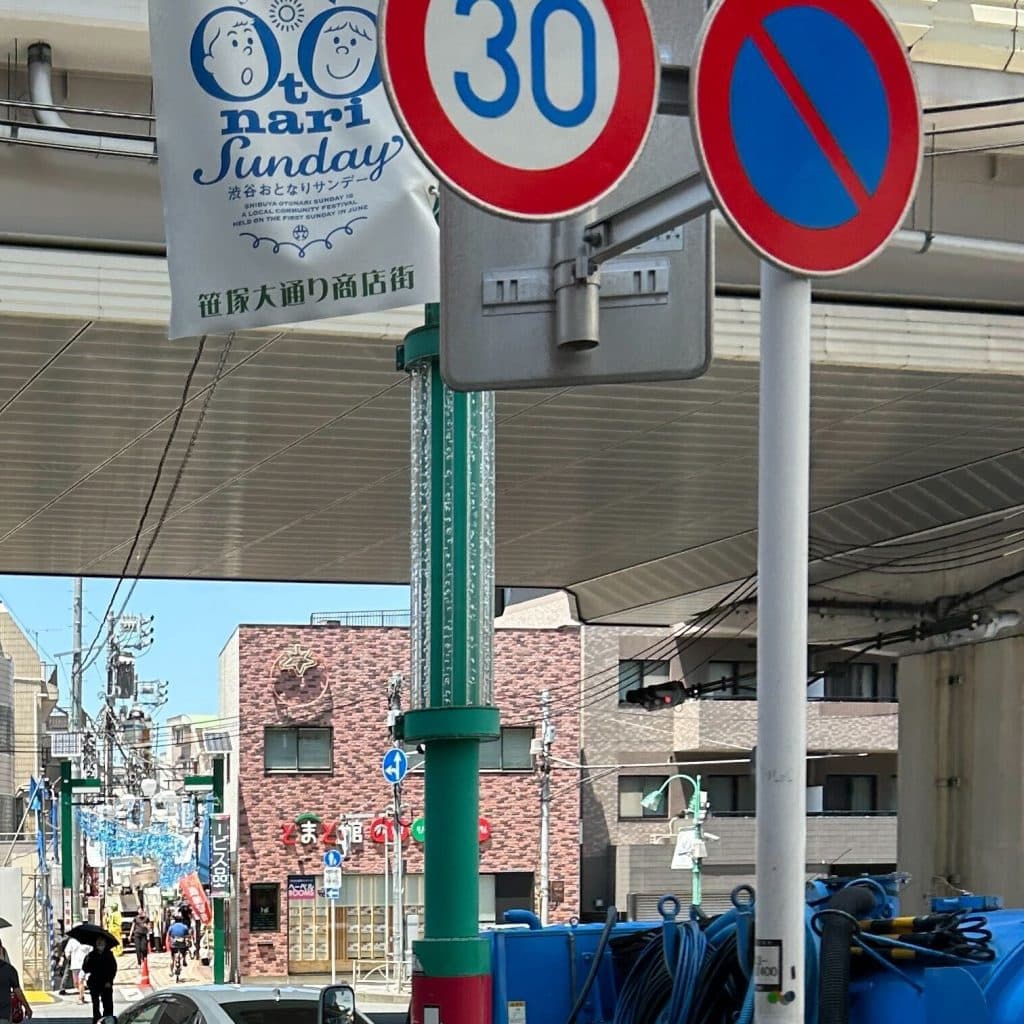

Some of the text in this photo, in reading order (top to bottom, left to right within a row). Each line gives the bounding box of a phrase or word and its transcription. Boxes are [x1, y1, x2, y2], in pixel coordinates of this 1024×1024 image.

[454, 0, 596, 128] 30
[220, 97, 370, 135] nari
[192, 135, 404, 185] Sunday
[228, 175, 369, 200] 渋谷おとなりサンデー
[245, 201, 277, 209] SHIBUYA
[314, 195, 344, 204] SUNDAY
[248, 208, 274, 217] LOCAL
[275, 204, 320, 214] COMMUNITY
[321, 200, 358, 210] FESTIVAL
[305, 210, 337, 219] SUNDAY
[348, 204, 369, 213] JUNE
[198, 264, 414, 318] 笹塚大通り商店街
